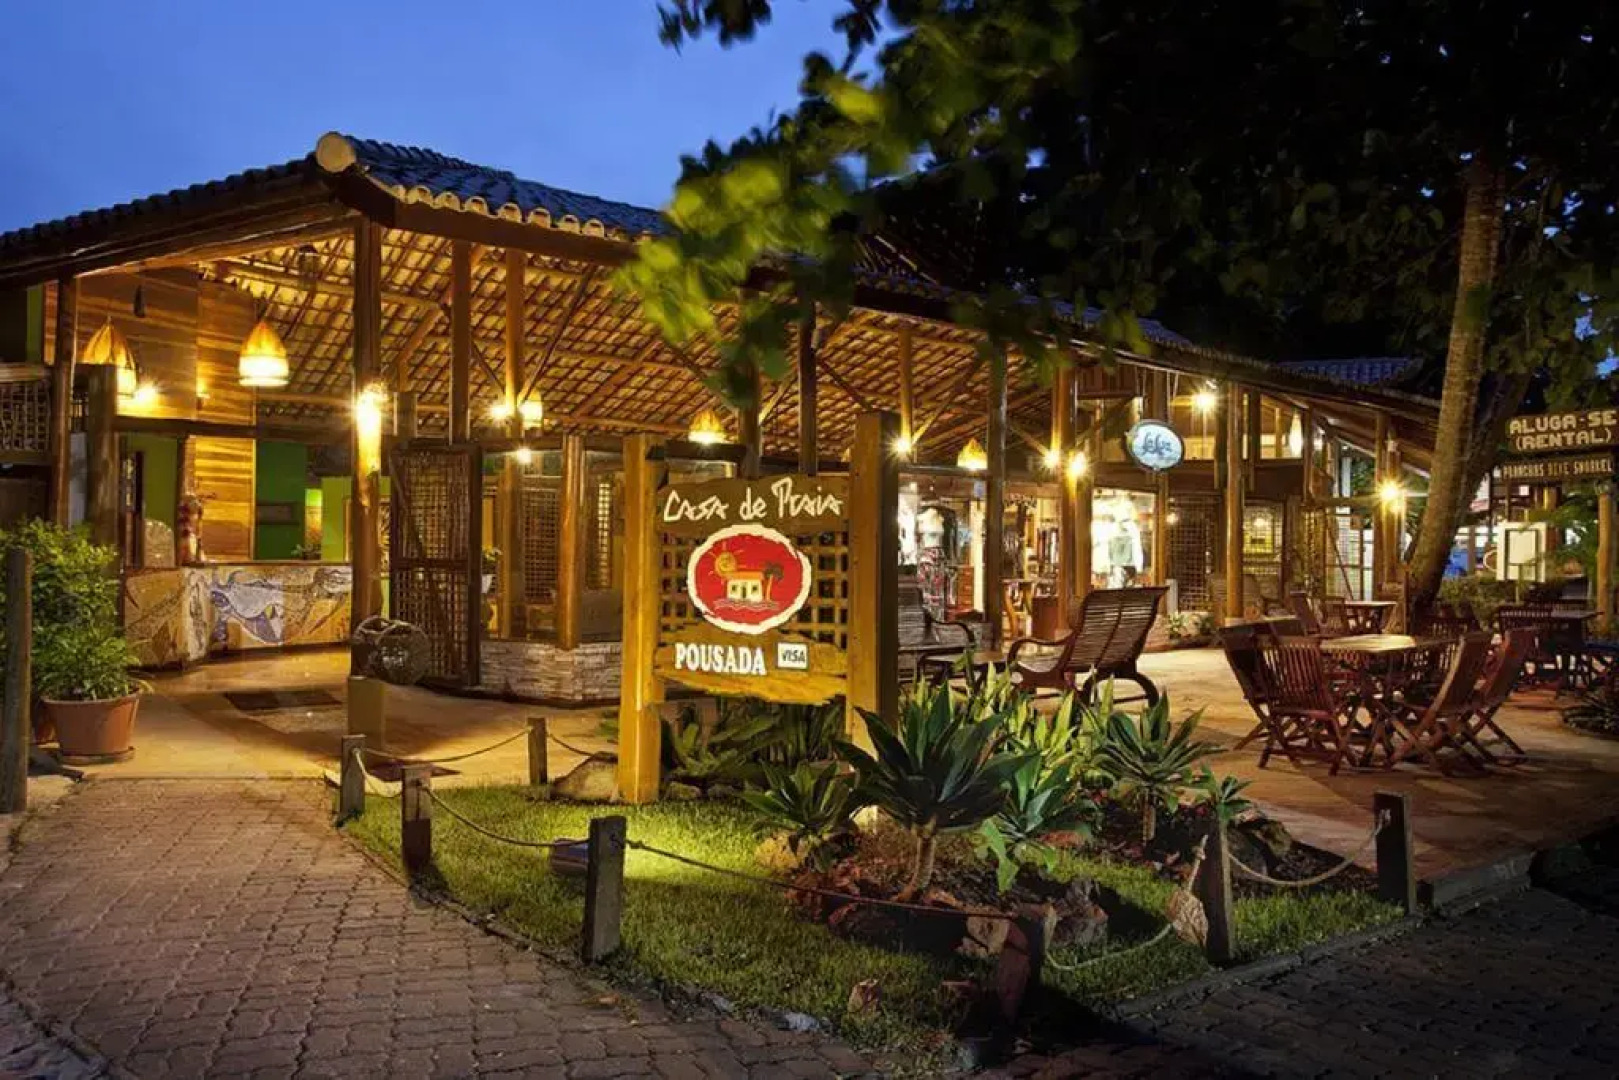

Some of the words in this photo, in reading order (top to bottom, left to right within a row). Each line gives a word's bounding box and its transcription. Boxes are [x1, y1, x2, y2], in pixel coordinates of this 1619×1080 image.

[1509, 410, 1616, 434] ALUGA-SE
[1515, 427, 1612, 450] (RENTAL)
[664, 490, 729, 521] Casa
[739, 487, 767, 519] de
[771, 476, 843, 517] Praia
[675, 643, 766, 675] POUSADA
[782, 649, 807, 662] VISA
